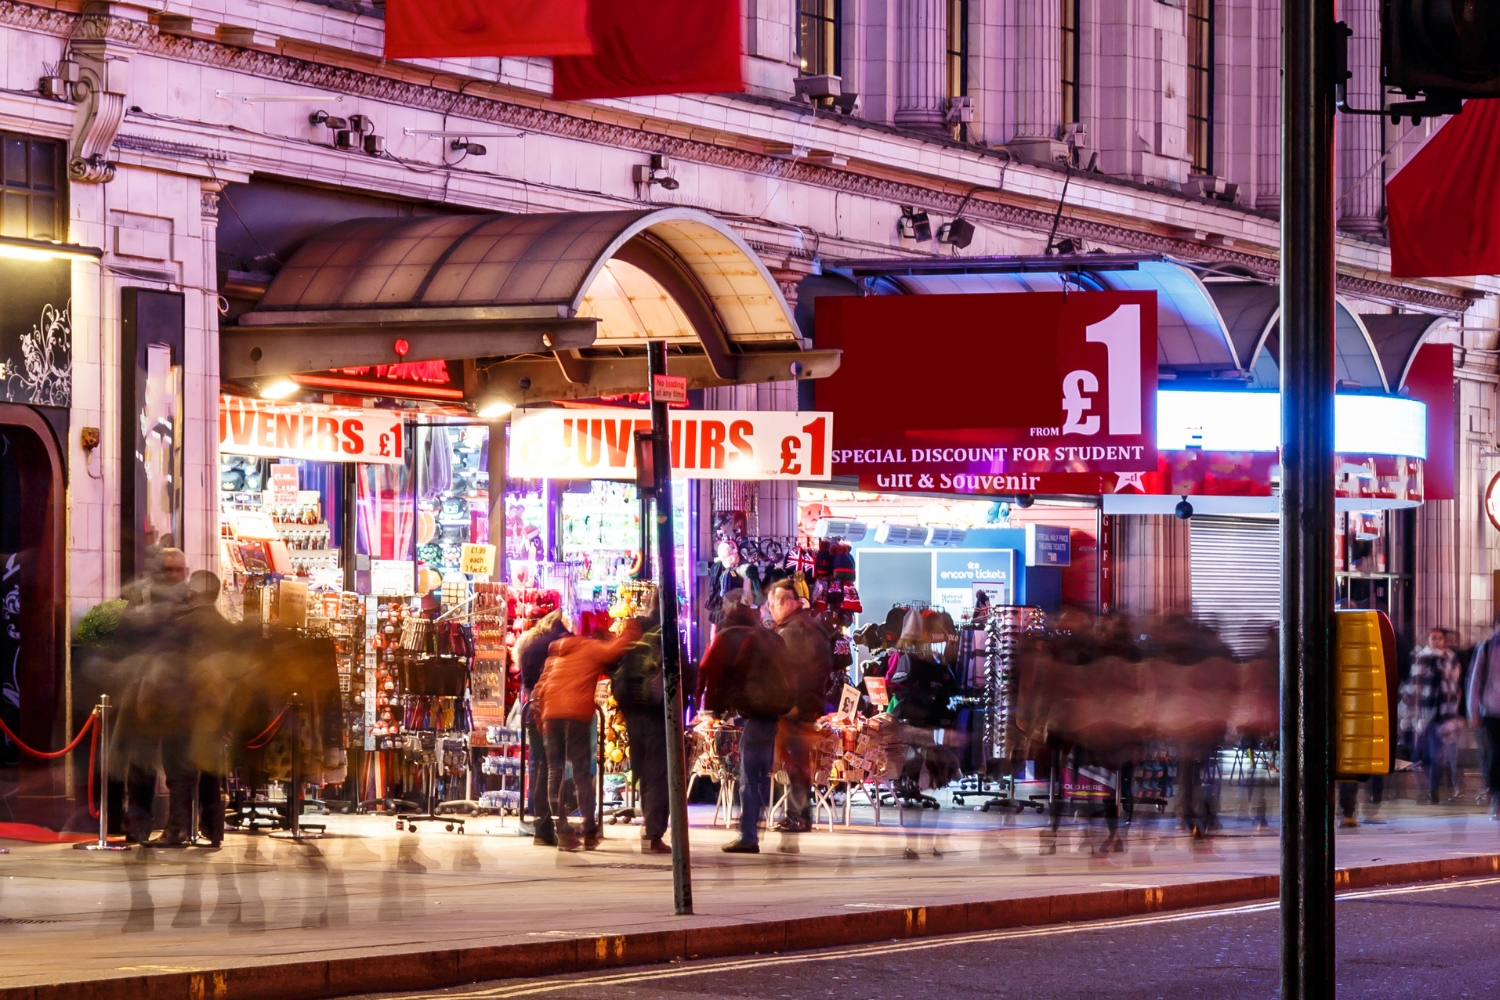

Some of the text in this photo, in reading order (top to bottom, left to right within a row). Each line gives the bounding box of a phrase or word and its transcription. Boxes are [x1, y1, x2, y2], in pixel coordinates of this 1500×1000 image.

[1062, 304, 1142, 436] £1
[656, 379, 684, 390] No loading
[662, 390, 672, 398] any
[673, 390, 684, 398] time
[1030, 427, 1059, 436] FROM
[379, 423, 402, 458] £1
[518, 419, 754, 469] UVIRS
[780, 417, 826, 475] £1
[832, 445, 1144, 464] SPECIAL DISCOUNT FOR STUDENT
[877, 472, 1041, 491] Gift & Souvenir
[1059, 534, 1069, 542] PRICE
[471, 546, 486, 554] £1.99
[1053, 543, 1066, 551] TICKETS
[941, 569, 1006, 579] encore tickets
[842, 697, 854, 714] £1
